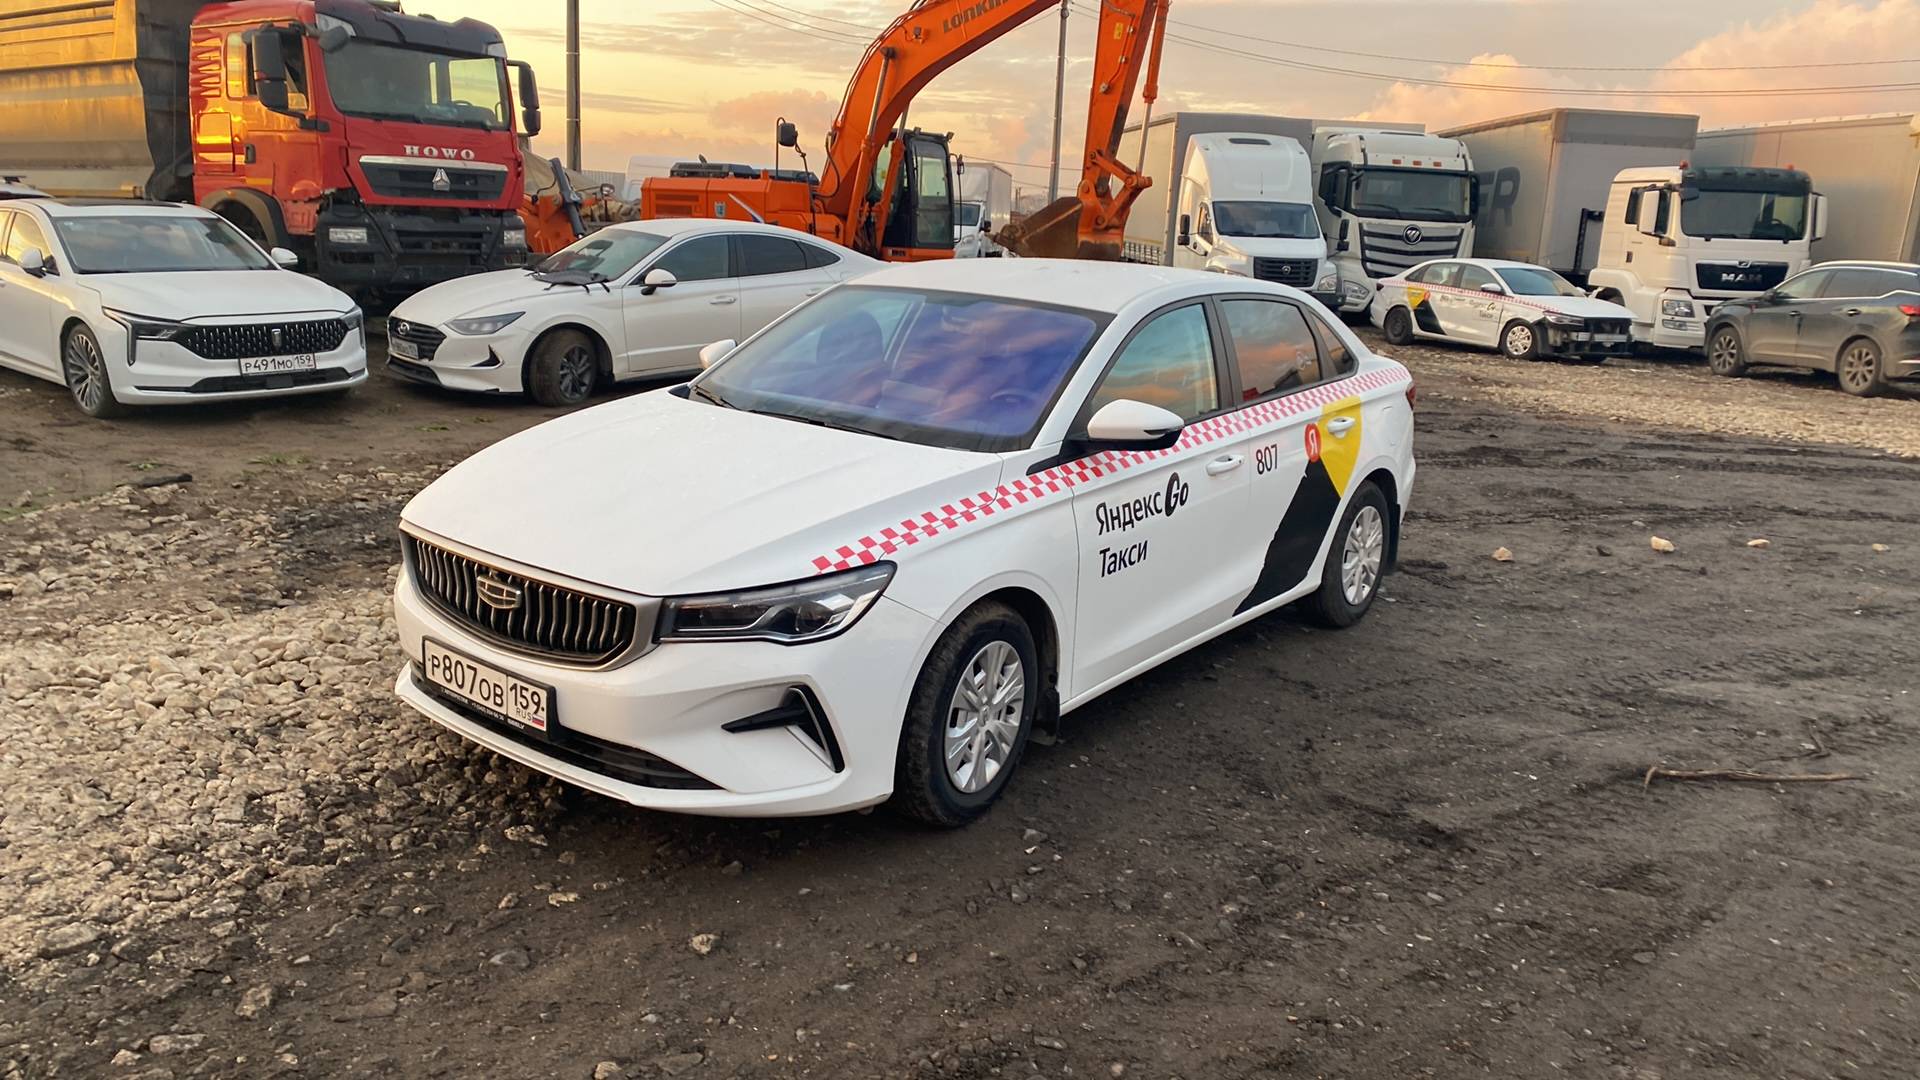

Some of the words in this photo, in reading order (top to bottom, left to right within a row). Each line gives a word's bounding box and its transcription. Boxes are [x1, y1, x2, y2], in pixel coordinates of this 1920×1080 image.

[404, 145, 475, 160] HOWO
[1721, 273, 1762, 282] MAN
[294, 355, 311, 366] 159
[1256, 444, 1277, 475] 807
[1096, 490, 1162, 536] Яндекс
[1165, 472, 1189, 517] Go
[1099, 540, 1148, 578] Такси
[509, 683, 541, 715] 159
[515, 707, 532, 721] RUS
